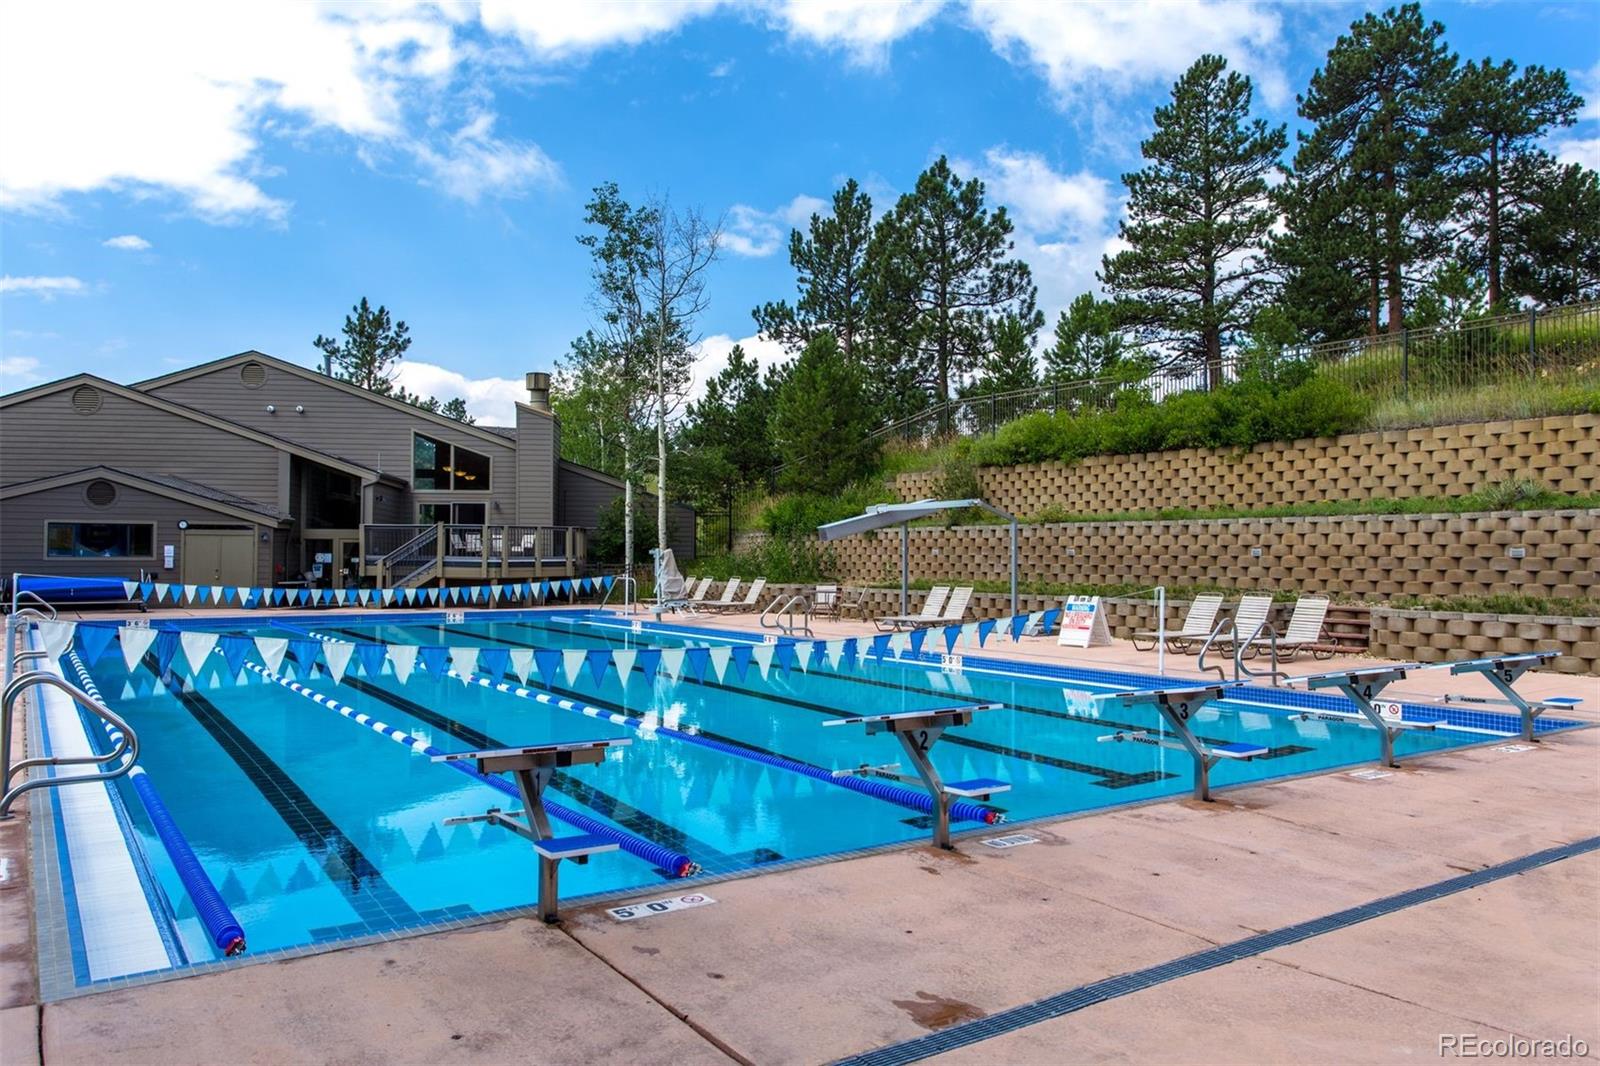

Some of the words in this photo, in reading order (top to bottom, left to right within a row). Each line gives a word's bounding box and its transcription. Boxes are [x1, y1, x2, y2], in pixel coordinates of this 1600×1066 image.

[1504, 669, 1513, 682] 5
[1363, 685, 1372, 699] 4
[1180, 702, 1188, 720] 3
[1317, 714, 1345, 722] PARAGON
[919, 730, 929, 751] 2
[1132, 736, 1160, 746] PARAGON
[875, 770, 900, 781] PARAGON
[612, 907, 636, 918] 5
[646, 902, 669, 912] 0
